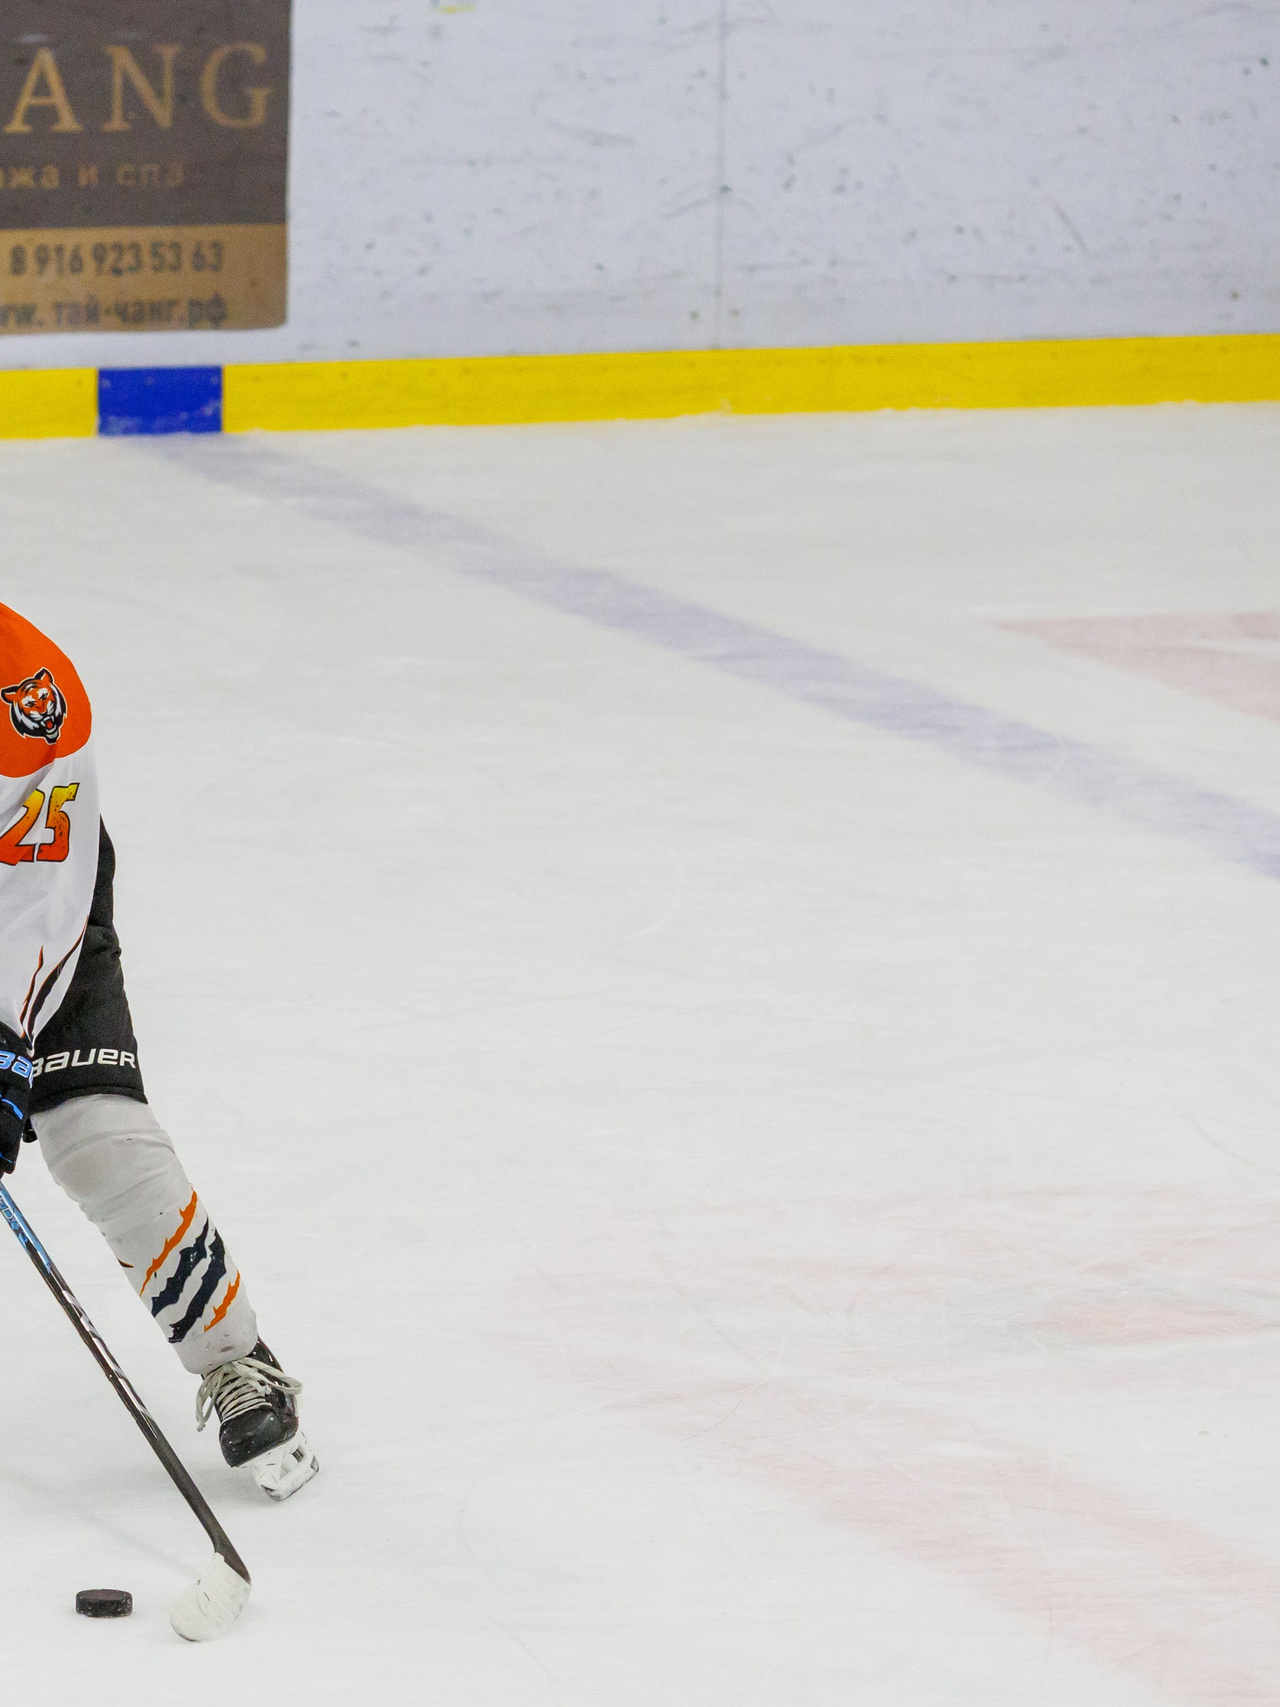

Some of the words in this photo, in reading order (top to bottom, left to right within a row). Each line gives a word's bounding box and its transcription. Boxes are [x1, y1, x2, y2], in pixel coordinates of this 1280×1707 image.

[77, 163, 100, 188] и
[9, 244, 27, 277] 8
[34, 243, 84, 276] 916
[92, 241, 143, 276] 923
[150, 240, 183, 273] 53
[191, 239, 224, 273] 63
[31, 1048, 136, 1078] BAUER
